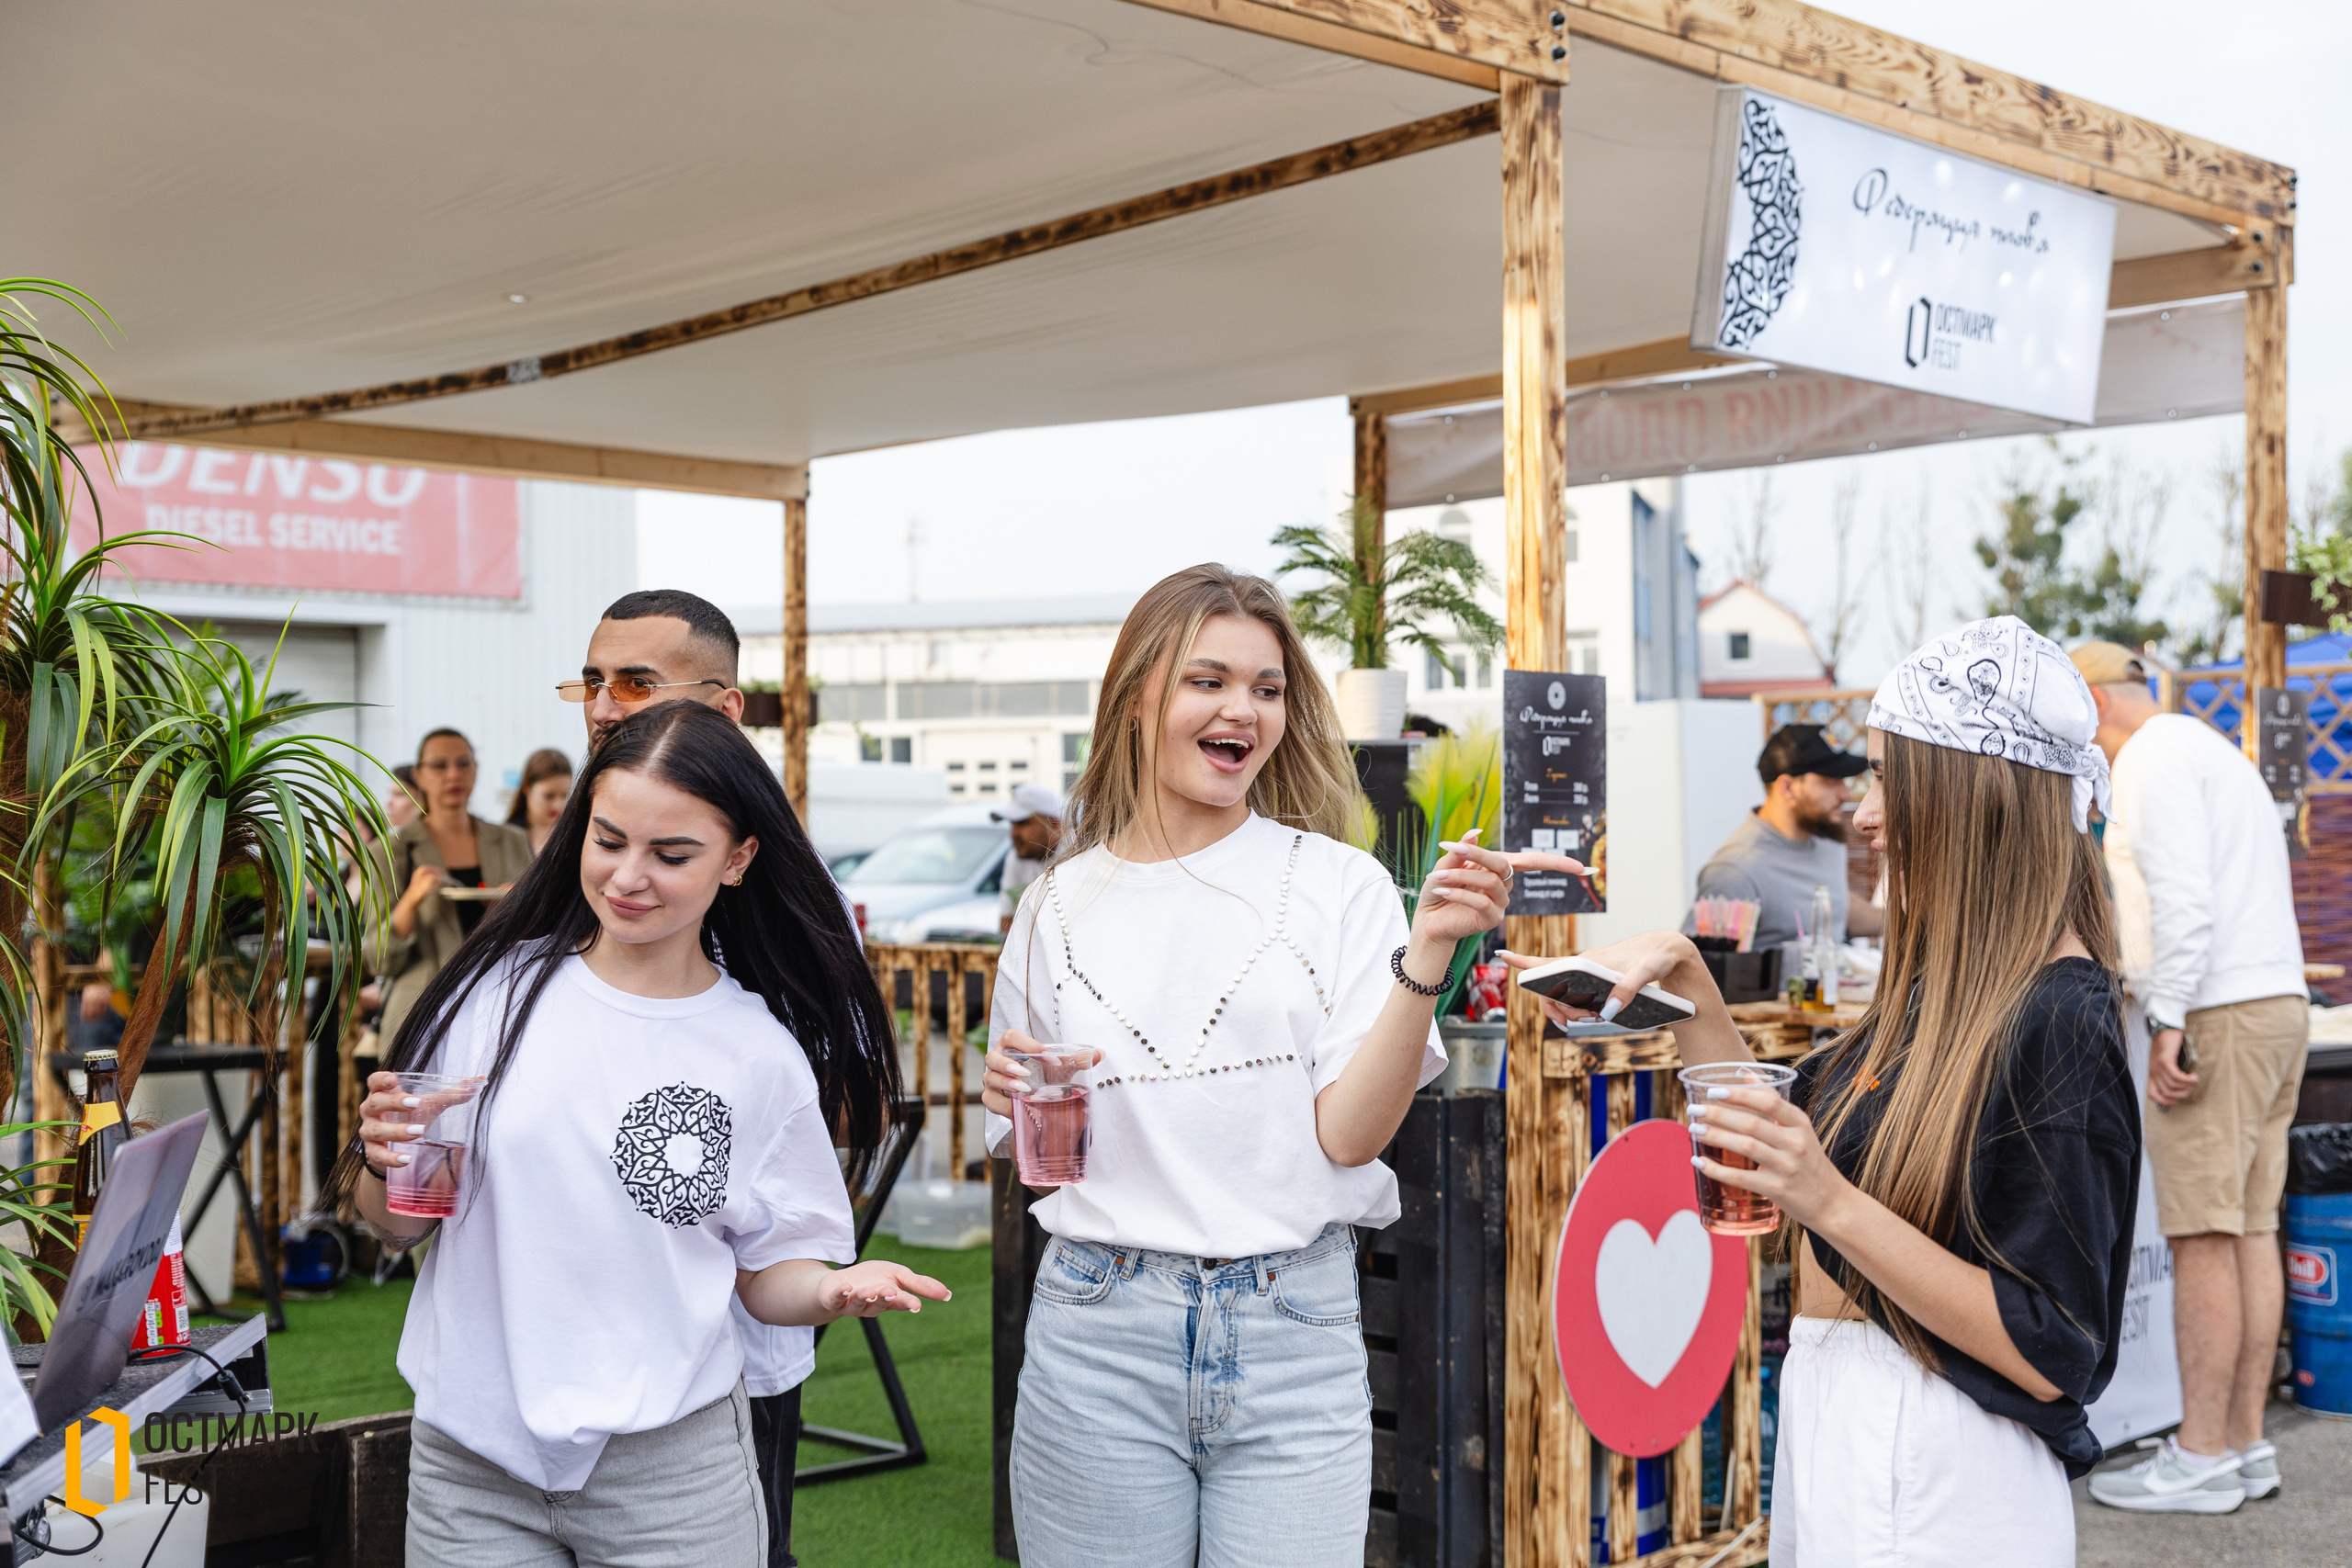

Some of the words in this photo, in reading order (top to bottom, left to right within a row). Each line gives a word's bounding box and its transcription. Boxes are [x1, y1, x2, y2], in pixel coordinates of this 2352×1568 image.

[1935, 303, 1997, 344] ОСТМАРК
[1931, 337, 1962, 369] FEST
[144, 502, 264, 548] DIESEL
[268, 511, 402, 556] SERVICE
